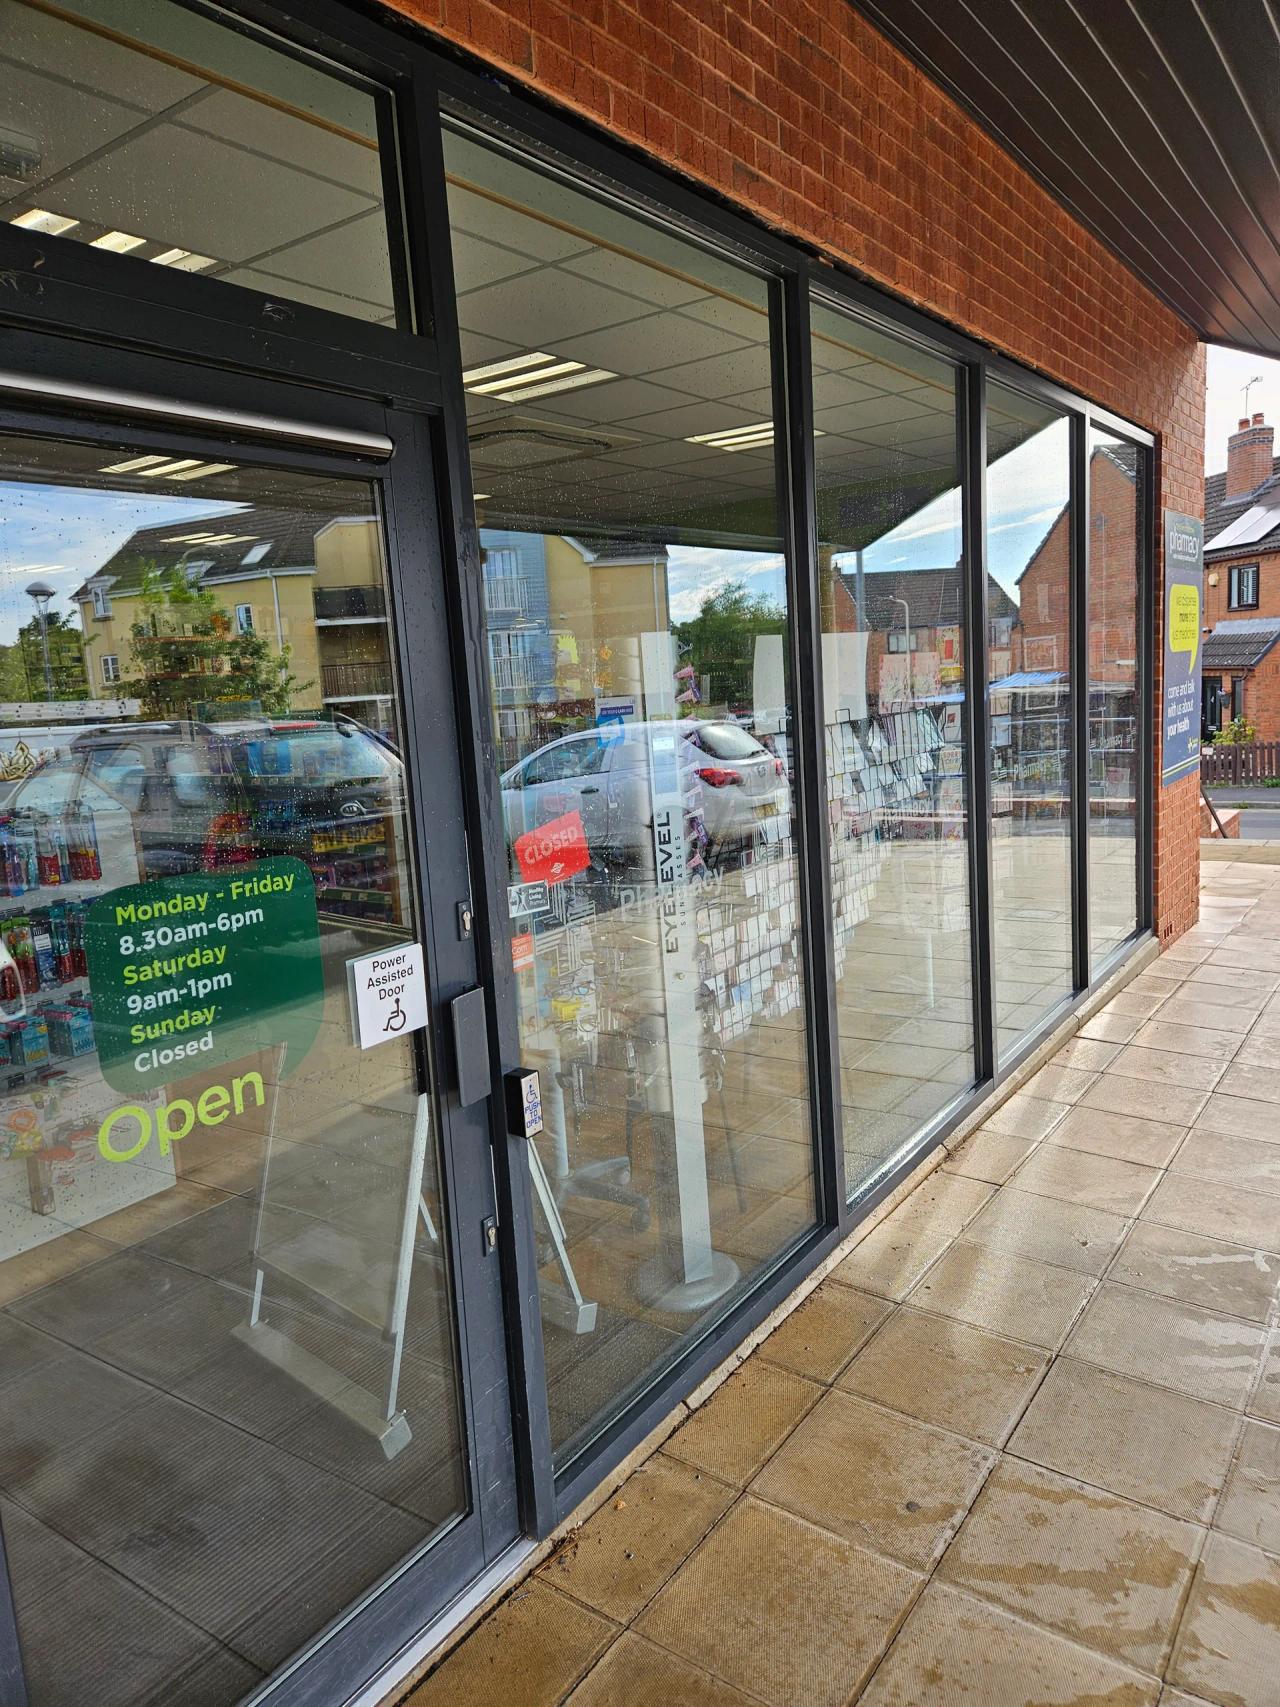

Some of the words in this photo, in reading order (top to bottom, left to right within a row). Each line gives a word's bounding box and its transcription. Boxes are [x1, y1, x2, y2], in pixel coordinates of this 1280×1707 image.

[1168, 685, 1179, 699] come
[1179, 681, 1187, 695] and
[1187, 679, 1195, 694] talk
[1168, 701, 1176, 718] with
[1181, 698, 1194, 713] about
[1168, 724, 1177, 740] your
[1177, 716, 1190, 733] health
[524, 827, 578, 865] CLOSED
[115, 891, 209, 926] Monday
[216, 891, 225, 899] -
[231, 873, 295, 900] Friday
[119, 907, 264, 956] 8.30am-6pm
[123, 945, 227, 985] Saturday
[372, 954, 406, 973] Power
[367, 964, 414, 990] Assisted
[127, 972, 233, 1015] 9am-1pm
[378, 984, 405, 1000] Door
[130, 1005, 216, 1045] Sunday
[134, 1031, 214, 1073] Closed
[97, 1071, 265, 1163] Open
[525, 1101, 542, 1114] PUSH
[530, 1110, 538, 1119] TO
[526, 1115, 544, 1129] OPEN
